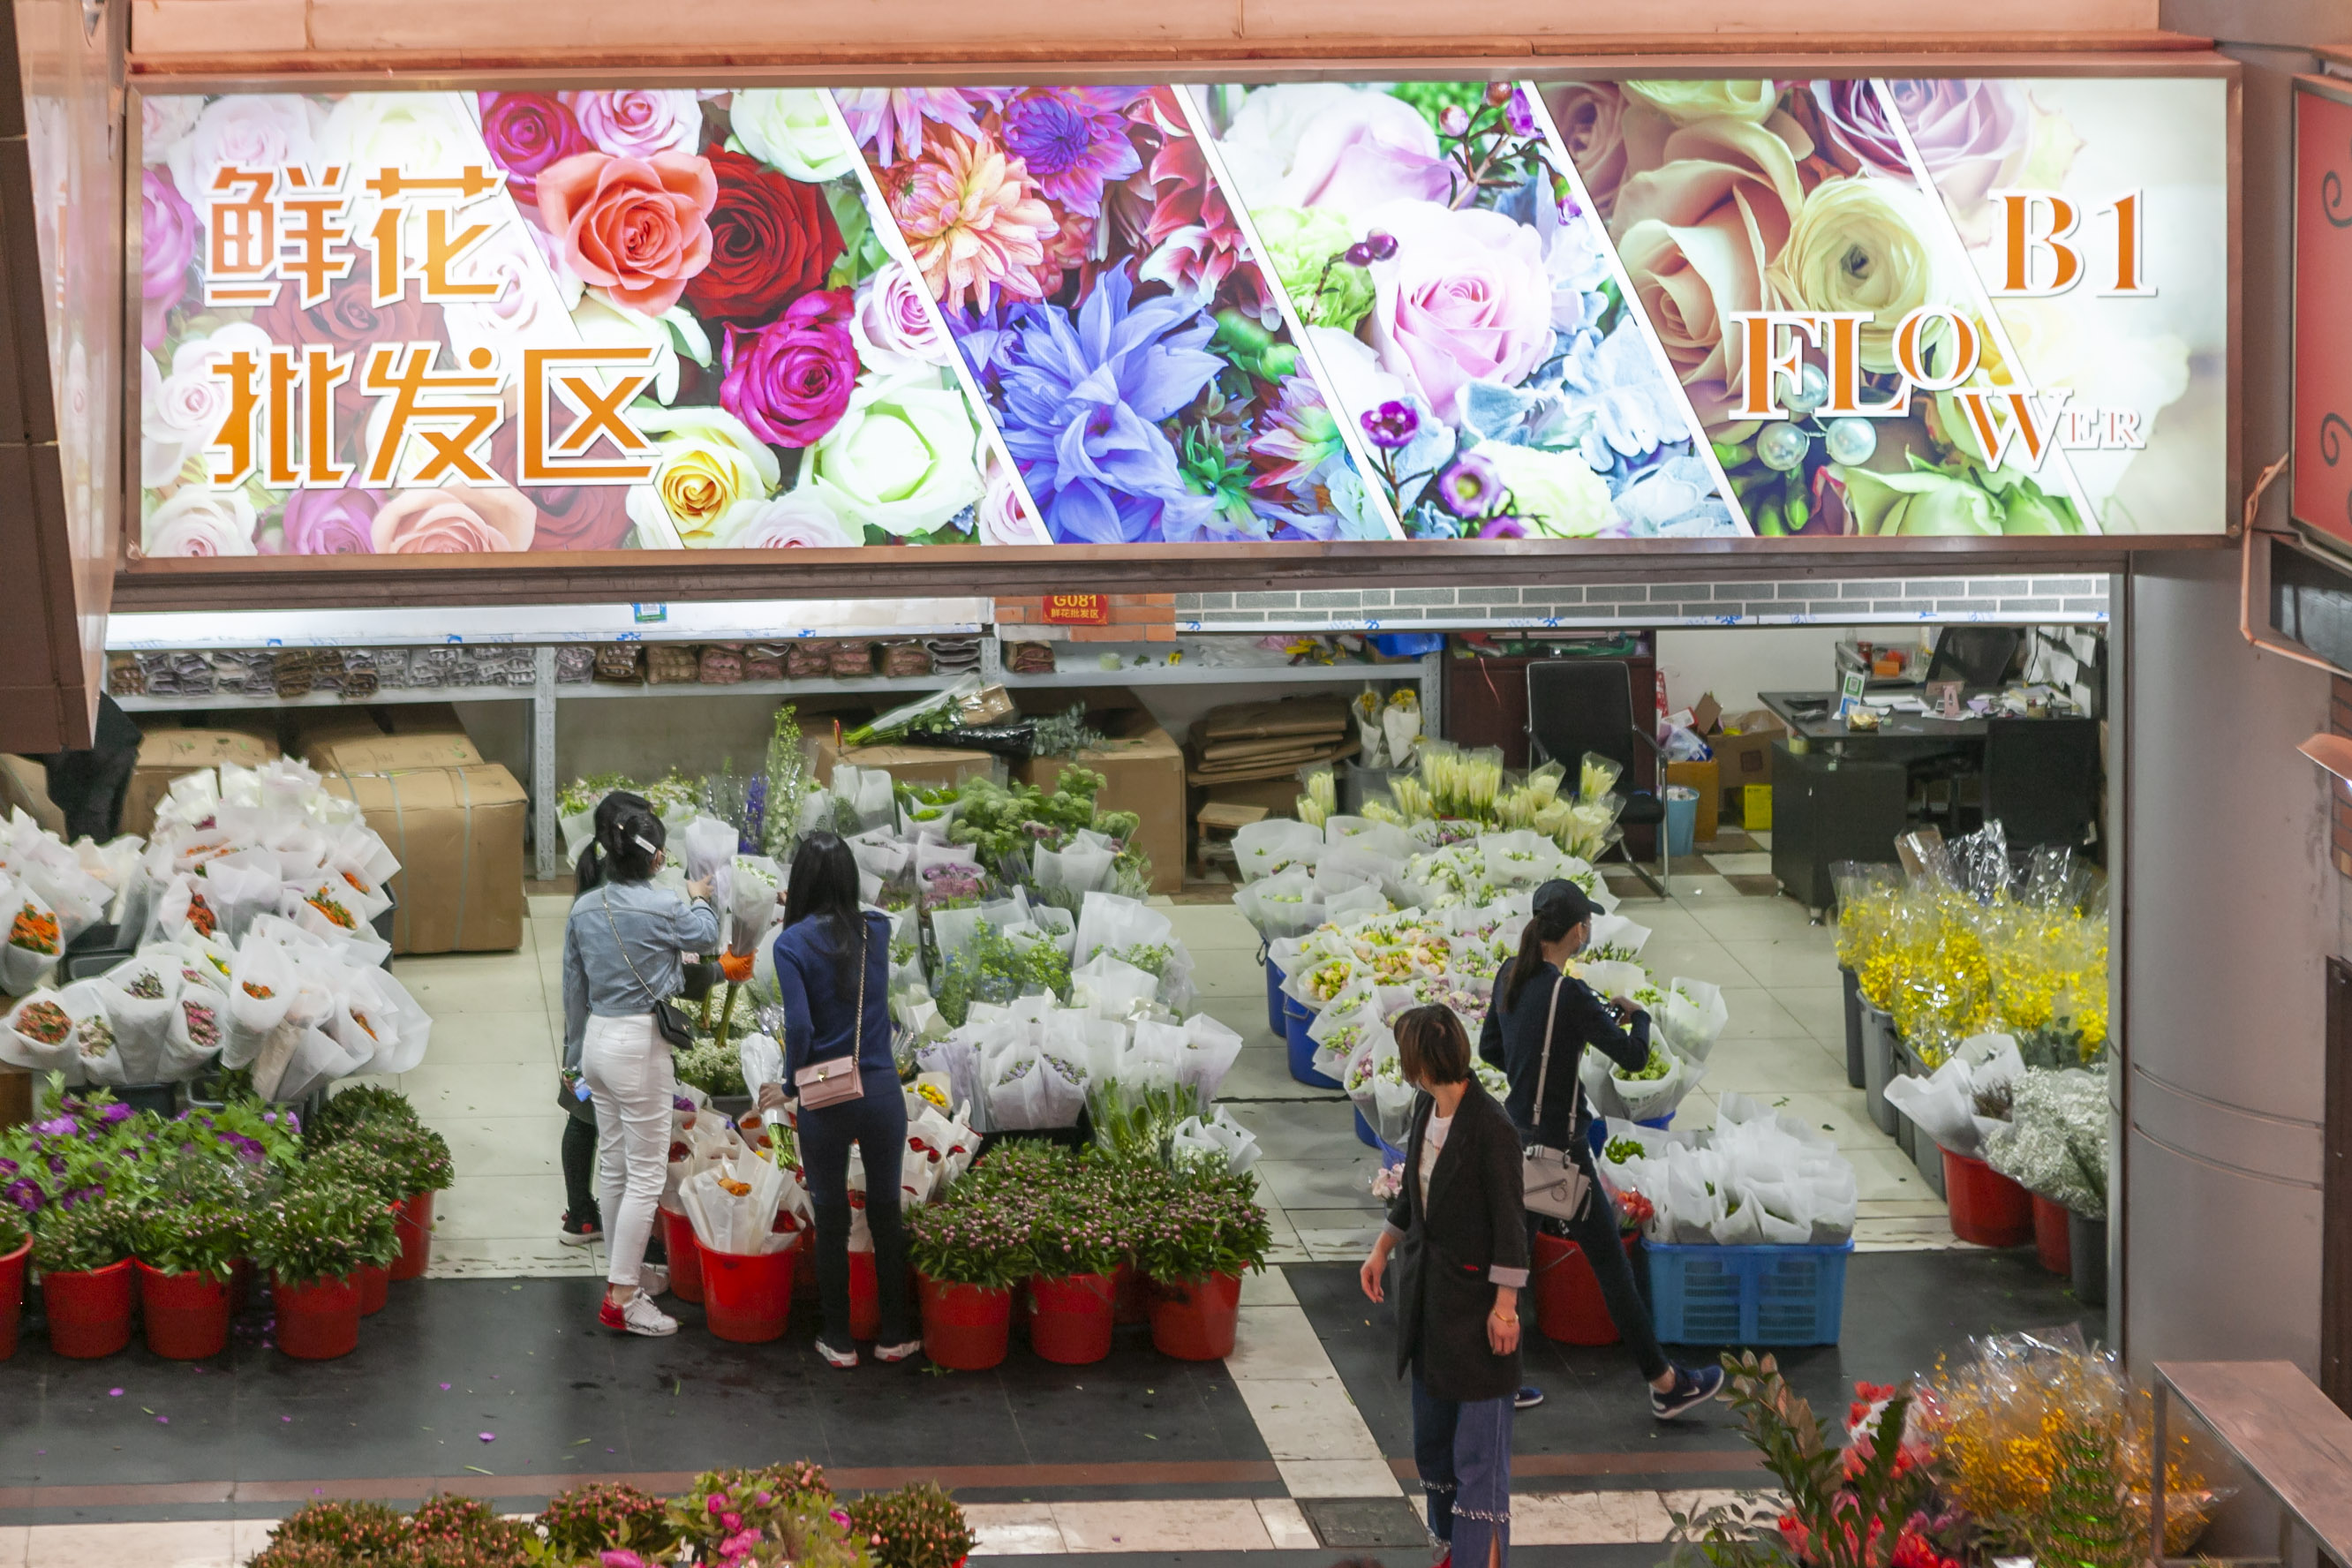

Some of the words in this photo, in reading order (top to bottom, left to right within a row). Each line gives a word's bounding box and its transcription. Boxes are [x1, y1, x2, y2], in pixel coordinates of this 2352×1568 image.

[205, 162, 509, 309] 鲜花
[1988, 188, 2158, 298] B1
[205, 341, 664, 490] 批发区
[1051, 608, 1099, 618] 鲜花批发区
[1053, 594, 1097, 607] G081
